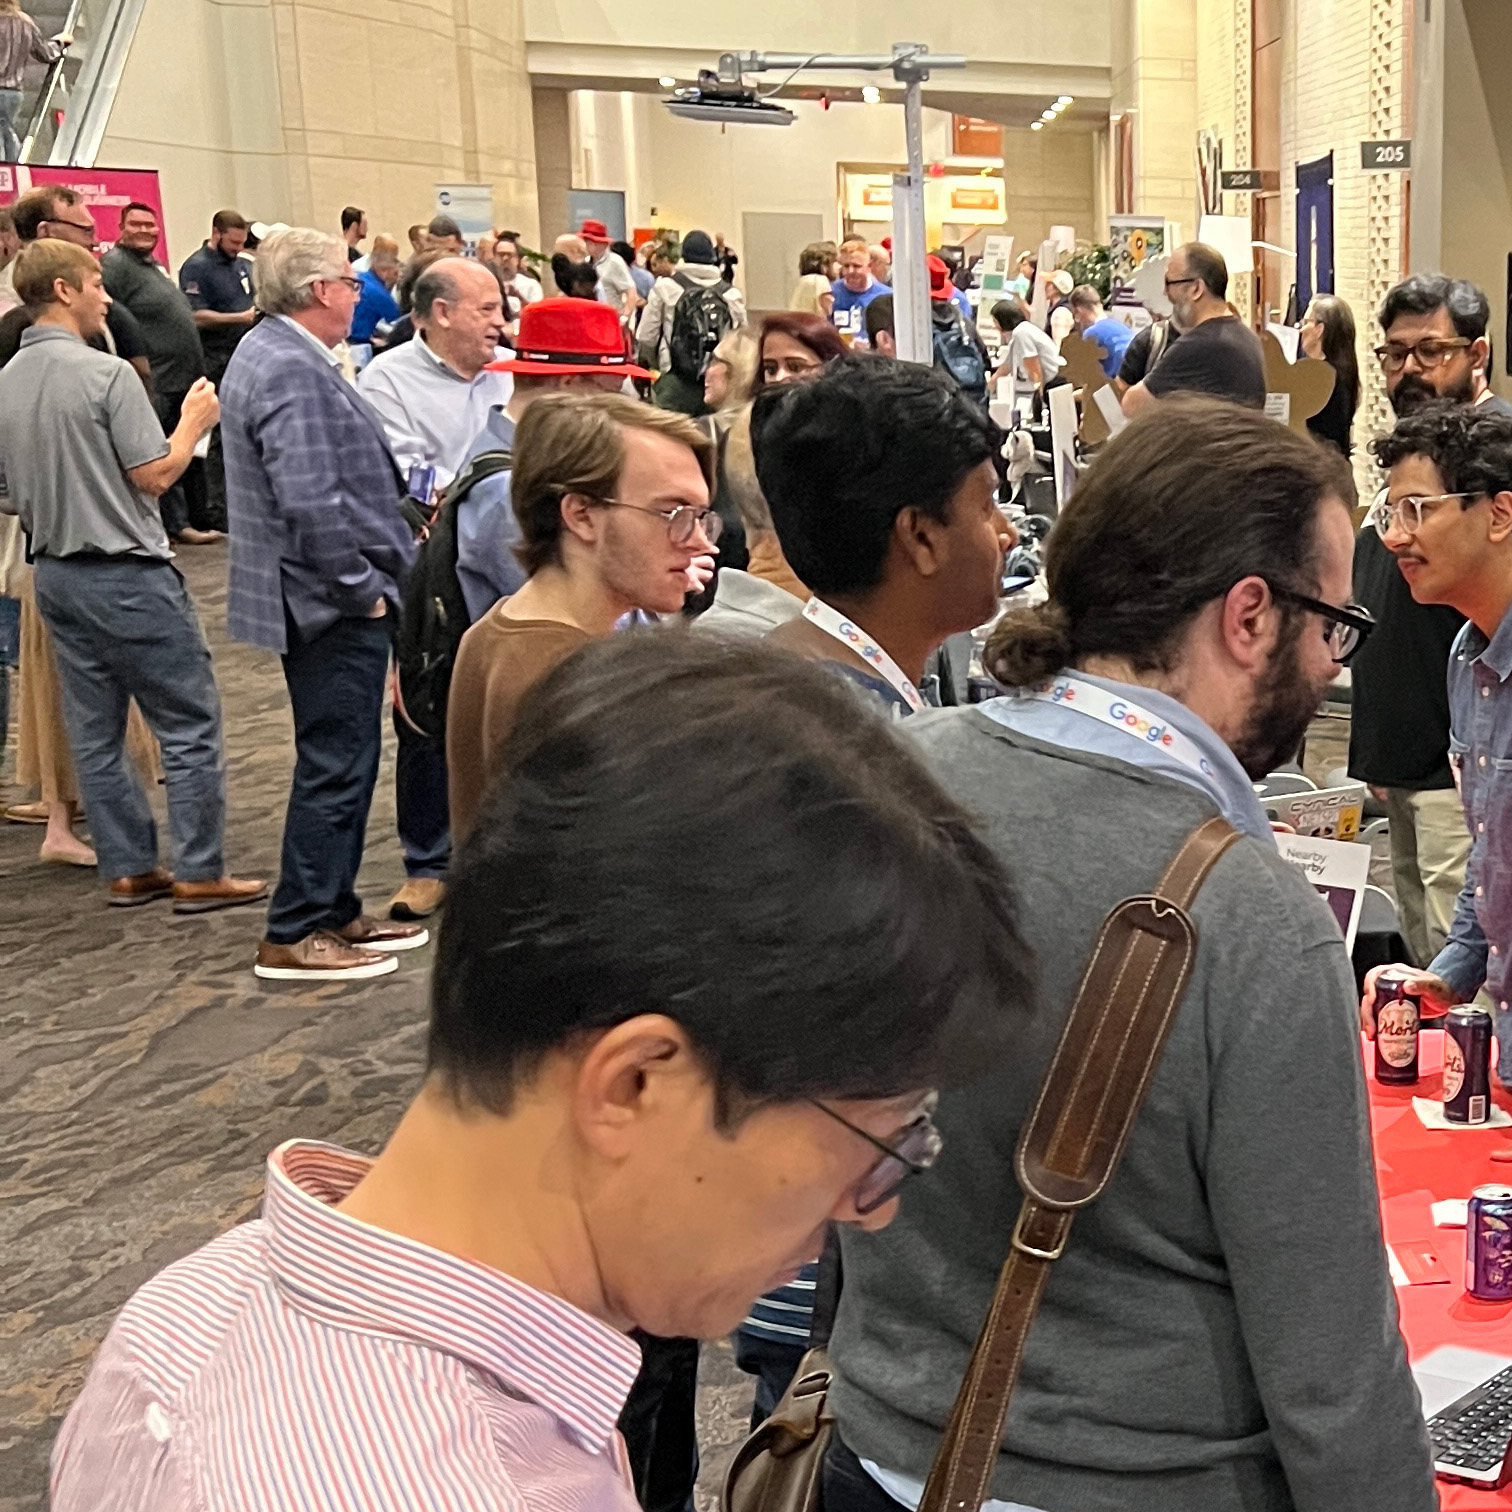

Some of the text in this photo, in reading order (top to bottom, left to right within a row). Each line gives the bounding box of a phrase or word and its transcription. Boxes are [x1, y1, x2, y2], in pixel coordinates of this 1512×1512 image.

[1375, 146, 1405, 163] 205
[838, 622, 883, 664] Google
[1052, 683, 1174, 747] gle Google
[1286, 848, 1328, 864] Nearby
[1301, 862, 1328, 876] arby
